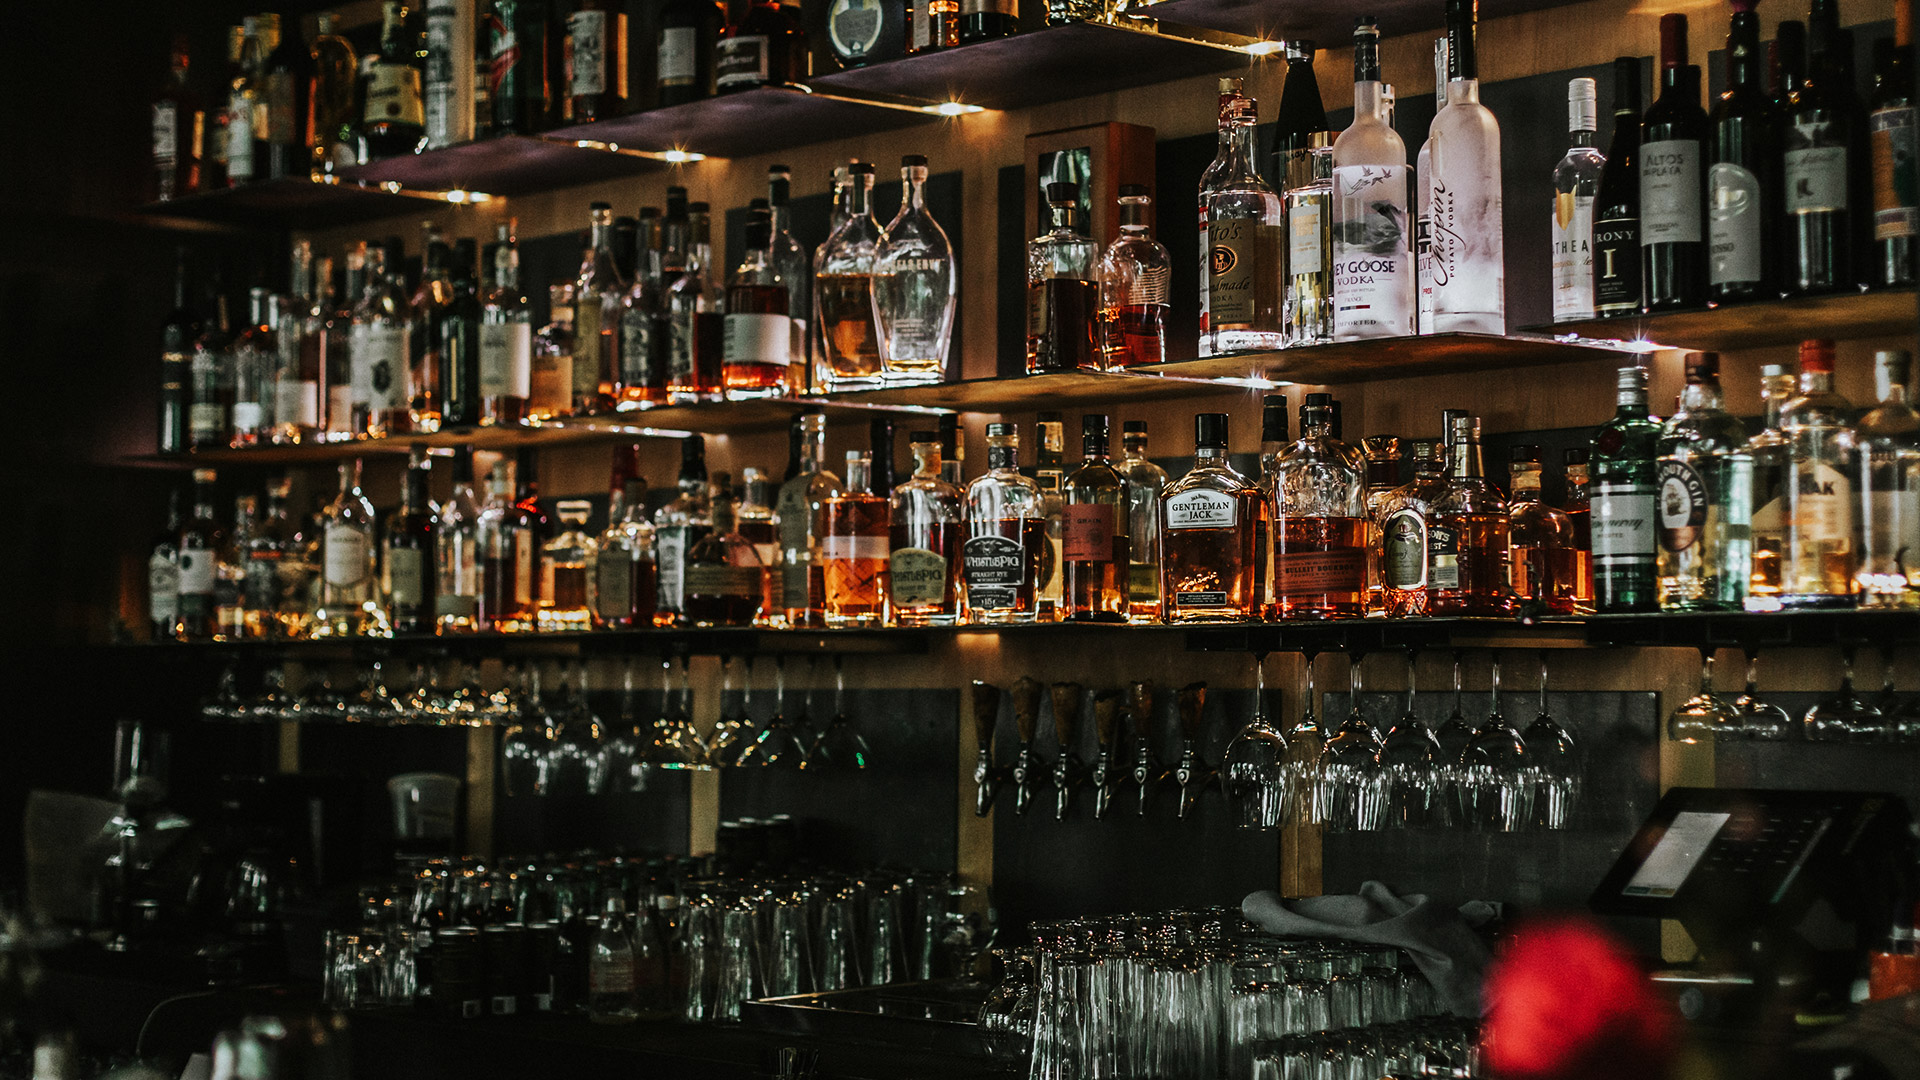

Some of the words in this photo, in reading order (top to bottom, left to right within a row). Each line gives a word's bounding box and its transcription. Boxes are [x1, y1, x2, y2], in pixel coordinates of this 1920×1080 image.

[1646, 154, 1684, 166] ALTOS
[1431, 179, 1466, 286] Chopin
[1552, 239, 1590, 255] THEA
[1335, 262, 1345, 276] EY
[1348, 260, 1395, 274] GOOSE
[1602, 248, 1617, 279] I
[1209, 276, 1250, 293] dmade
[1337, 275, 1375, 286] VODKA
[1211, 295, 1233, 303] ODKA
[1688, 480, 1704, 507] GIN
[1171, 501, 1230, 512] GENTLEMAN
[1189, 510, 1213, 520] JACK
[1285, 566, 1315, 574] BULLEIT
[1317, 564, 1354, 572] BOURBON
